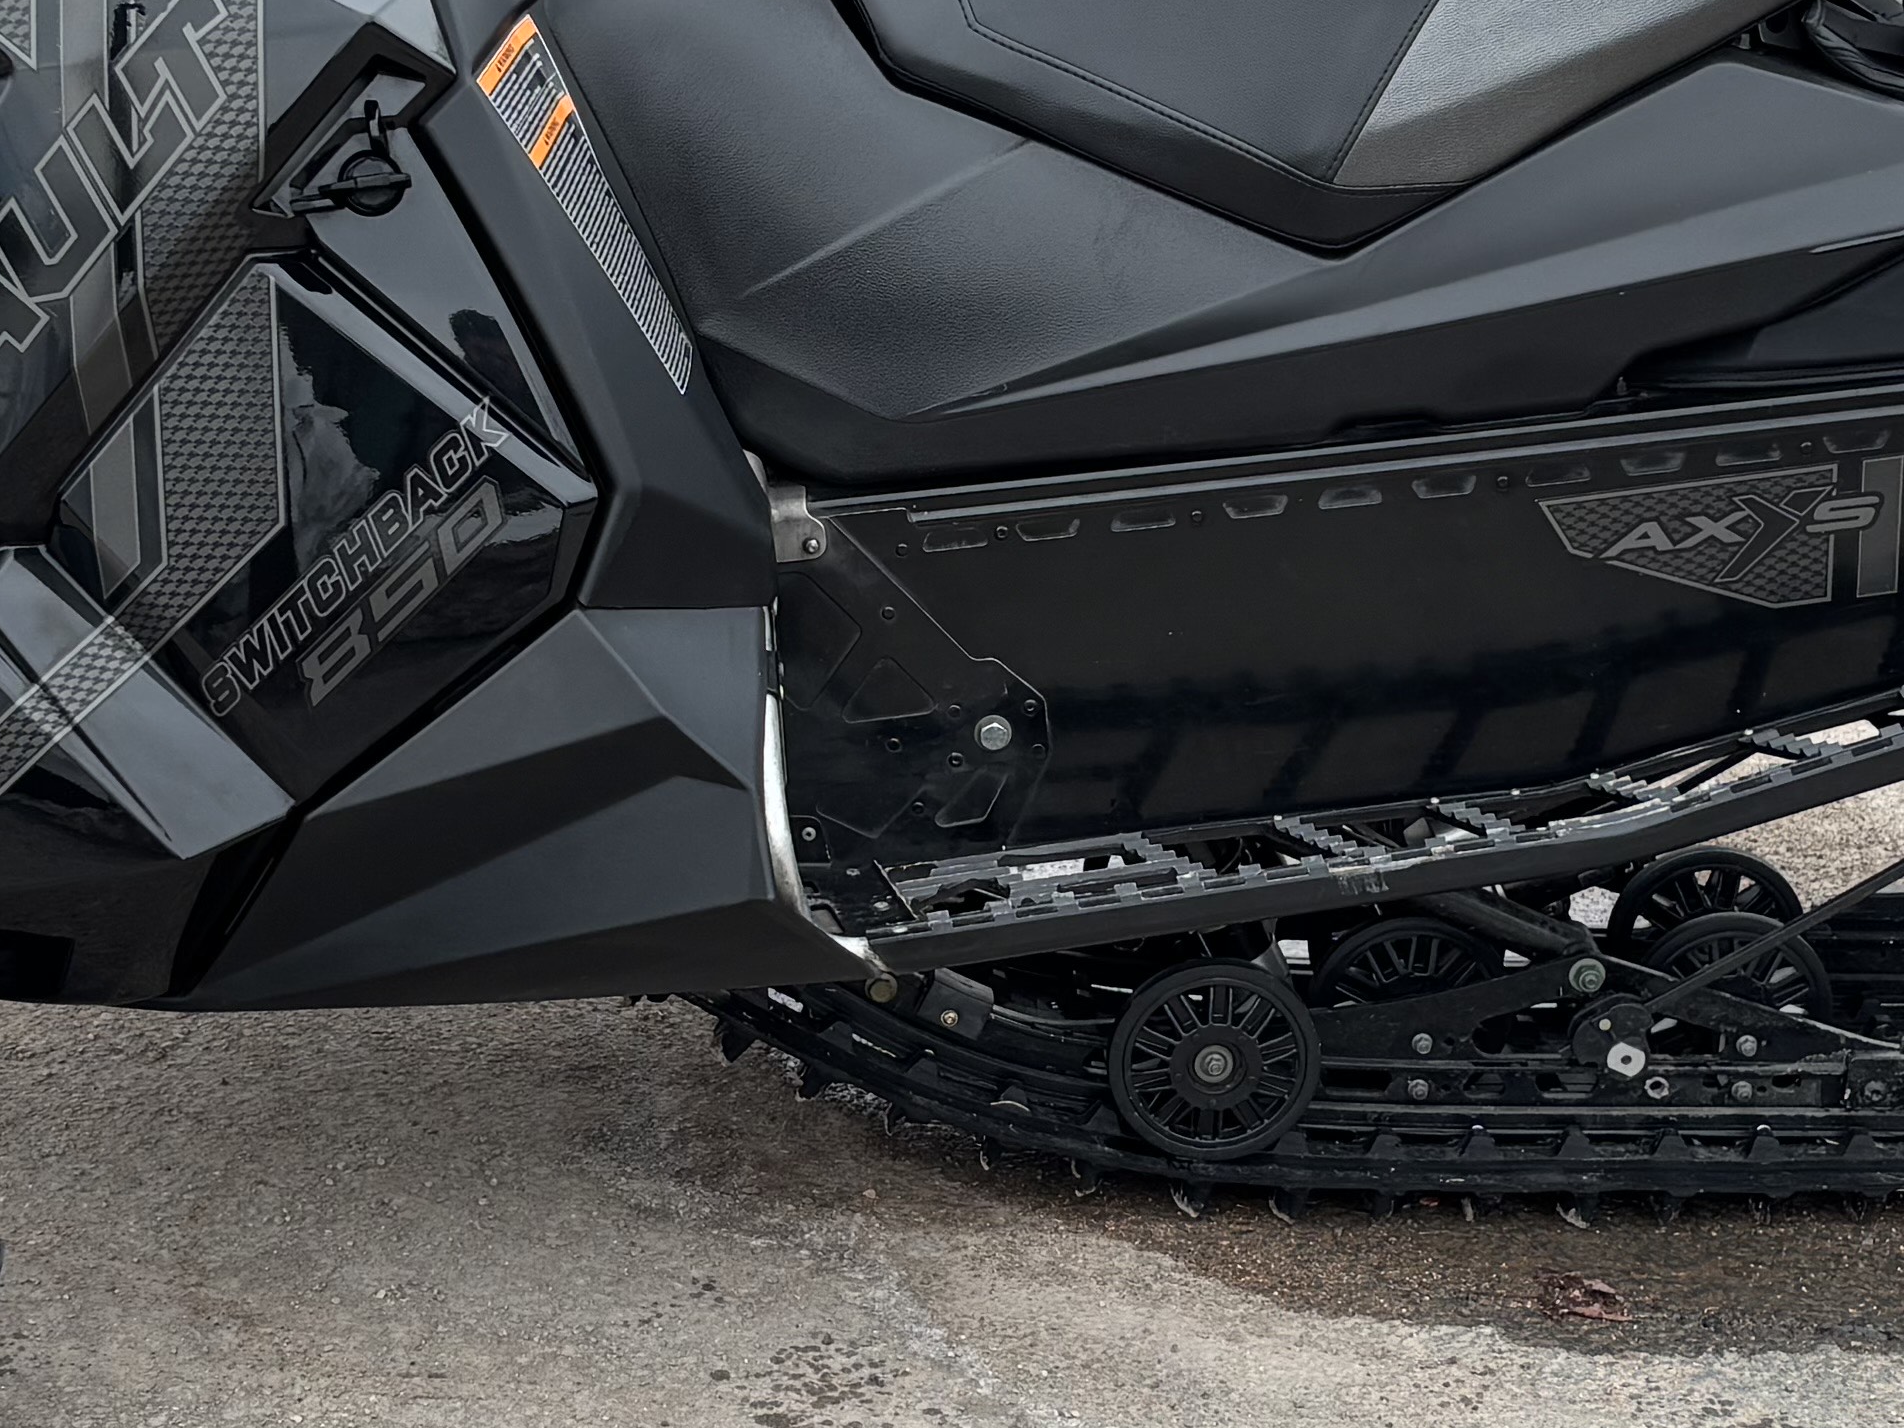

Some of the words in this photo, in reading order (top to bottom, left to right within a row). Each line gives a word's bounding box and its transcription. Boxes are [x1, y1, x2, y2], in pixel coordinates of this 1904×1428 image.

[201, 396, 511, 717] SWITCHBACK
[297, 476, 506, 709] 850
[1598, 484, 1881, 584] AXYS
